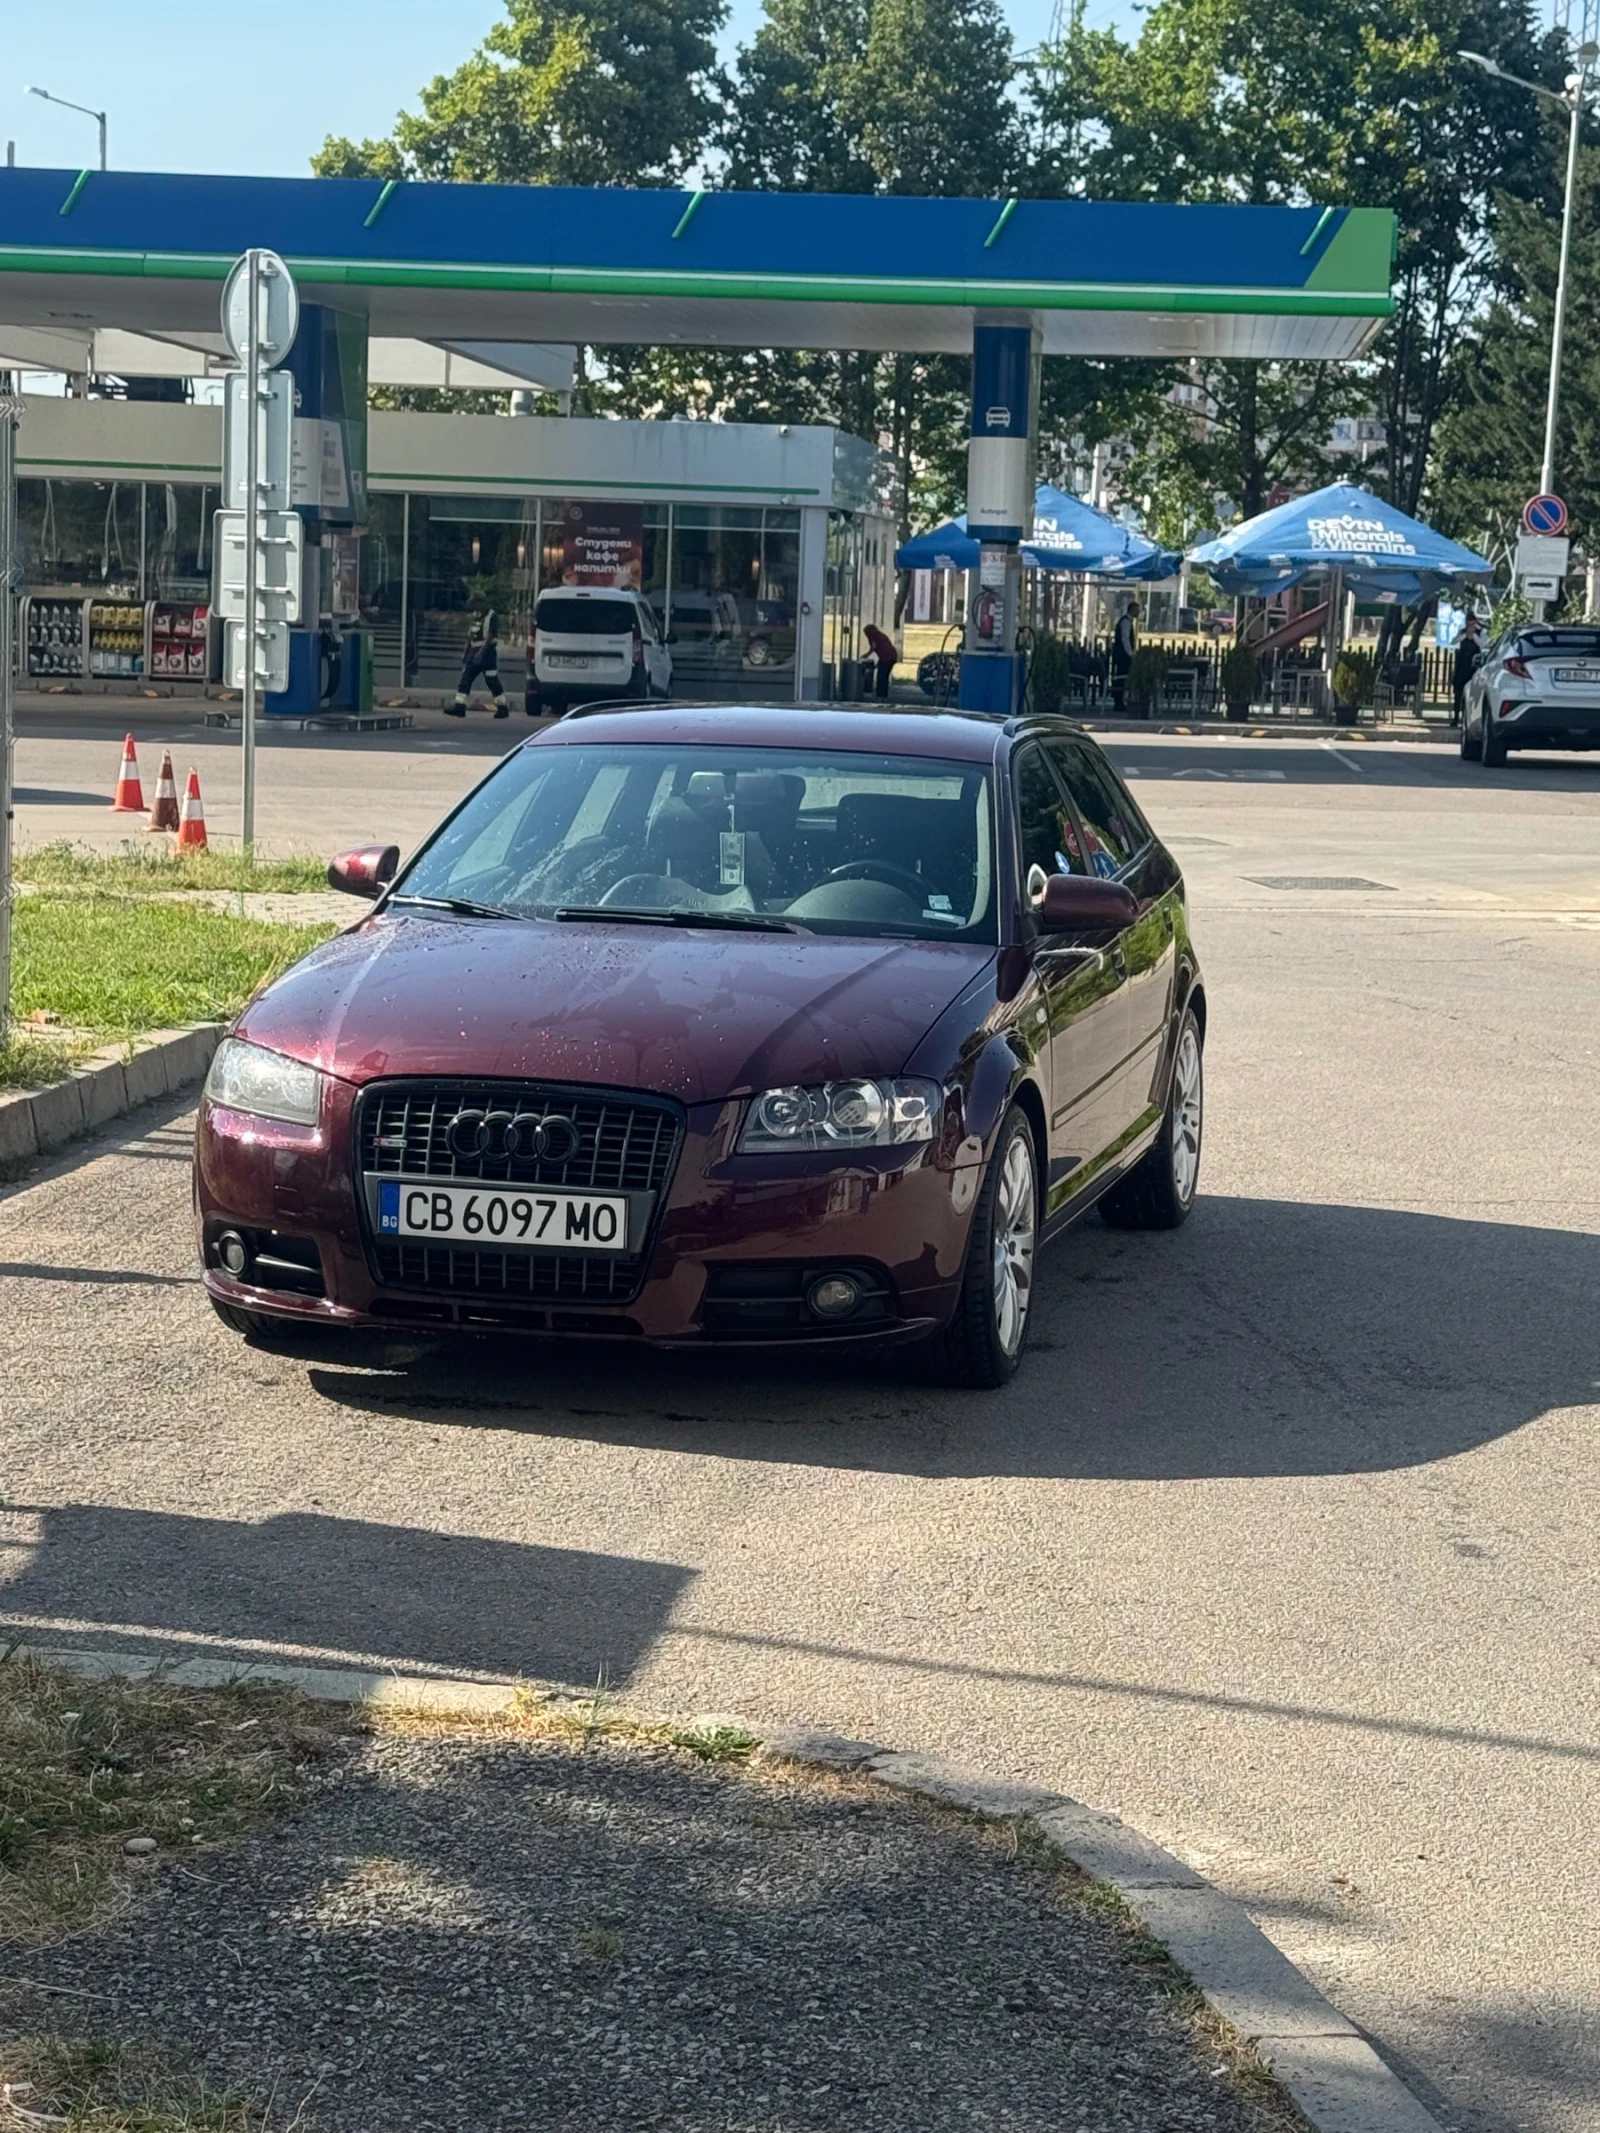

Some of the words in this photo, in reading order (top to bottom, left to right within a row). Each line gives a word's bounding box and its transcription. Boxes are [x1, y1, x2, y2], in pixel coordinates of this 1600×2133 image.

[1307, 517, 1385, 532] DEVIN
[1319, 528, 1406, 543] Minerals
[1325, 538, 1416, 555] Vitamins
[382, 1215, 398, 1228] BG
[406, 1191, 453, 1232] CB
[462, 1195, 557, 1238] 6097
[565, 1201, 617, 1242] MO
